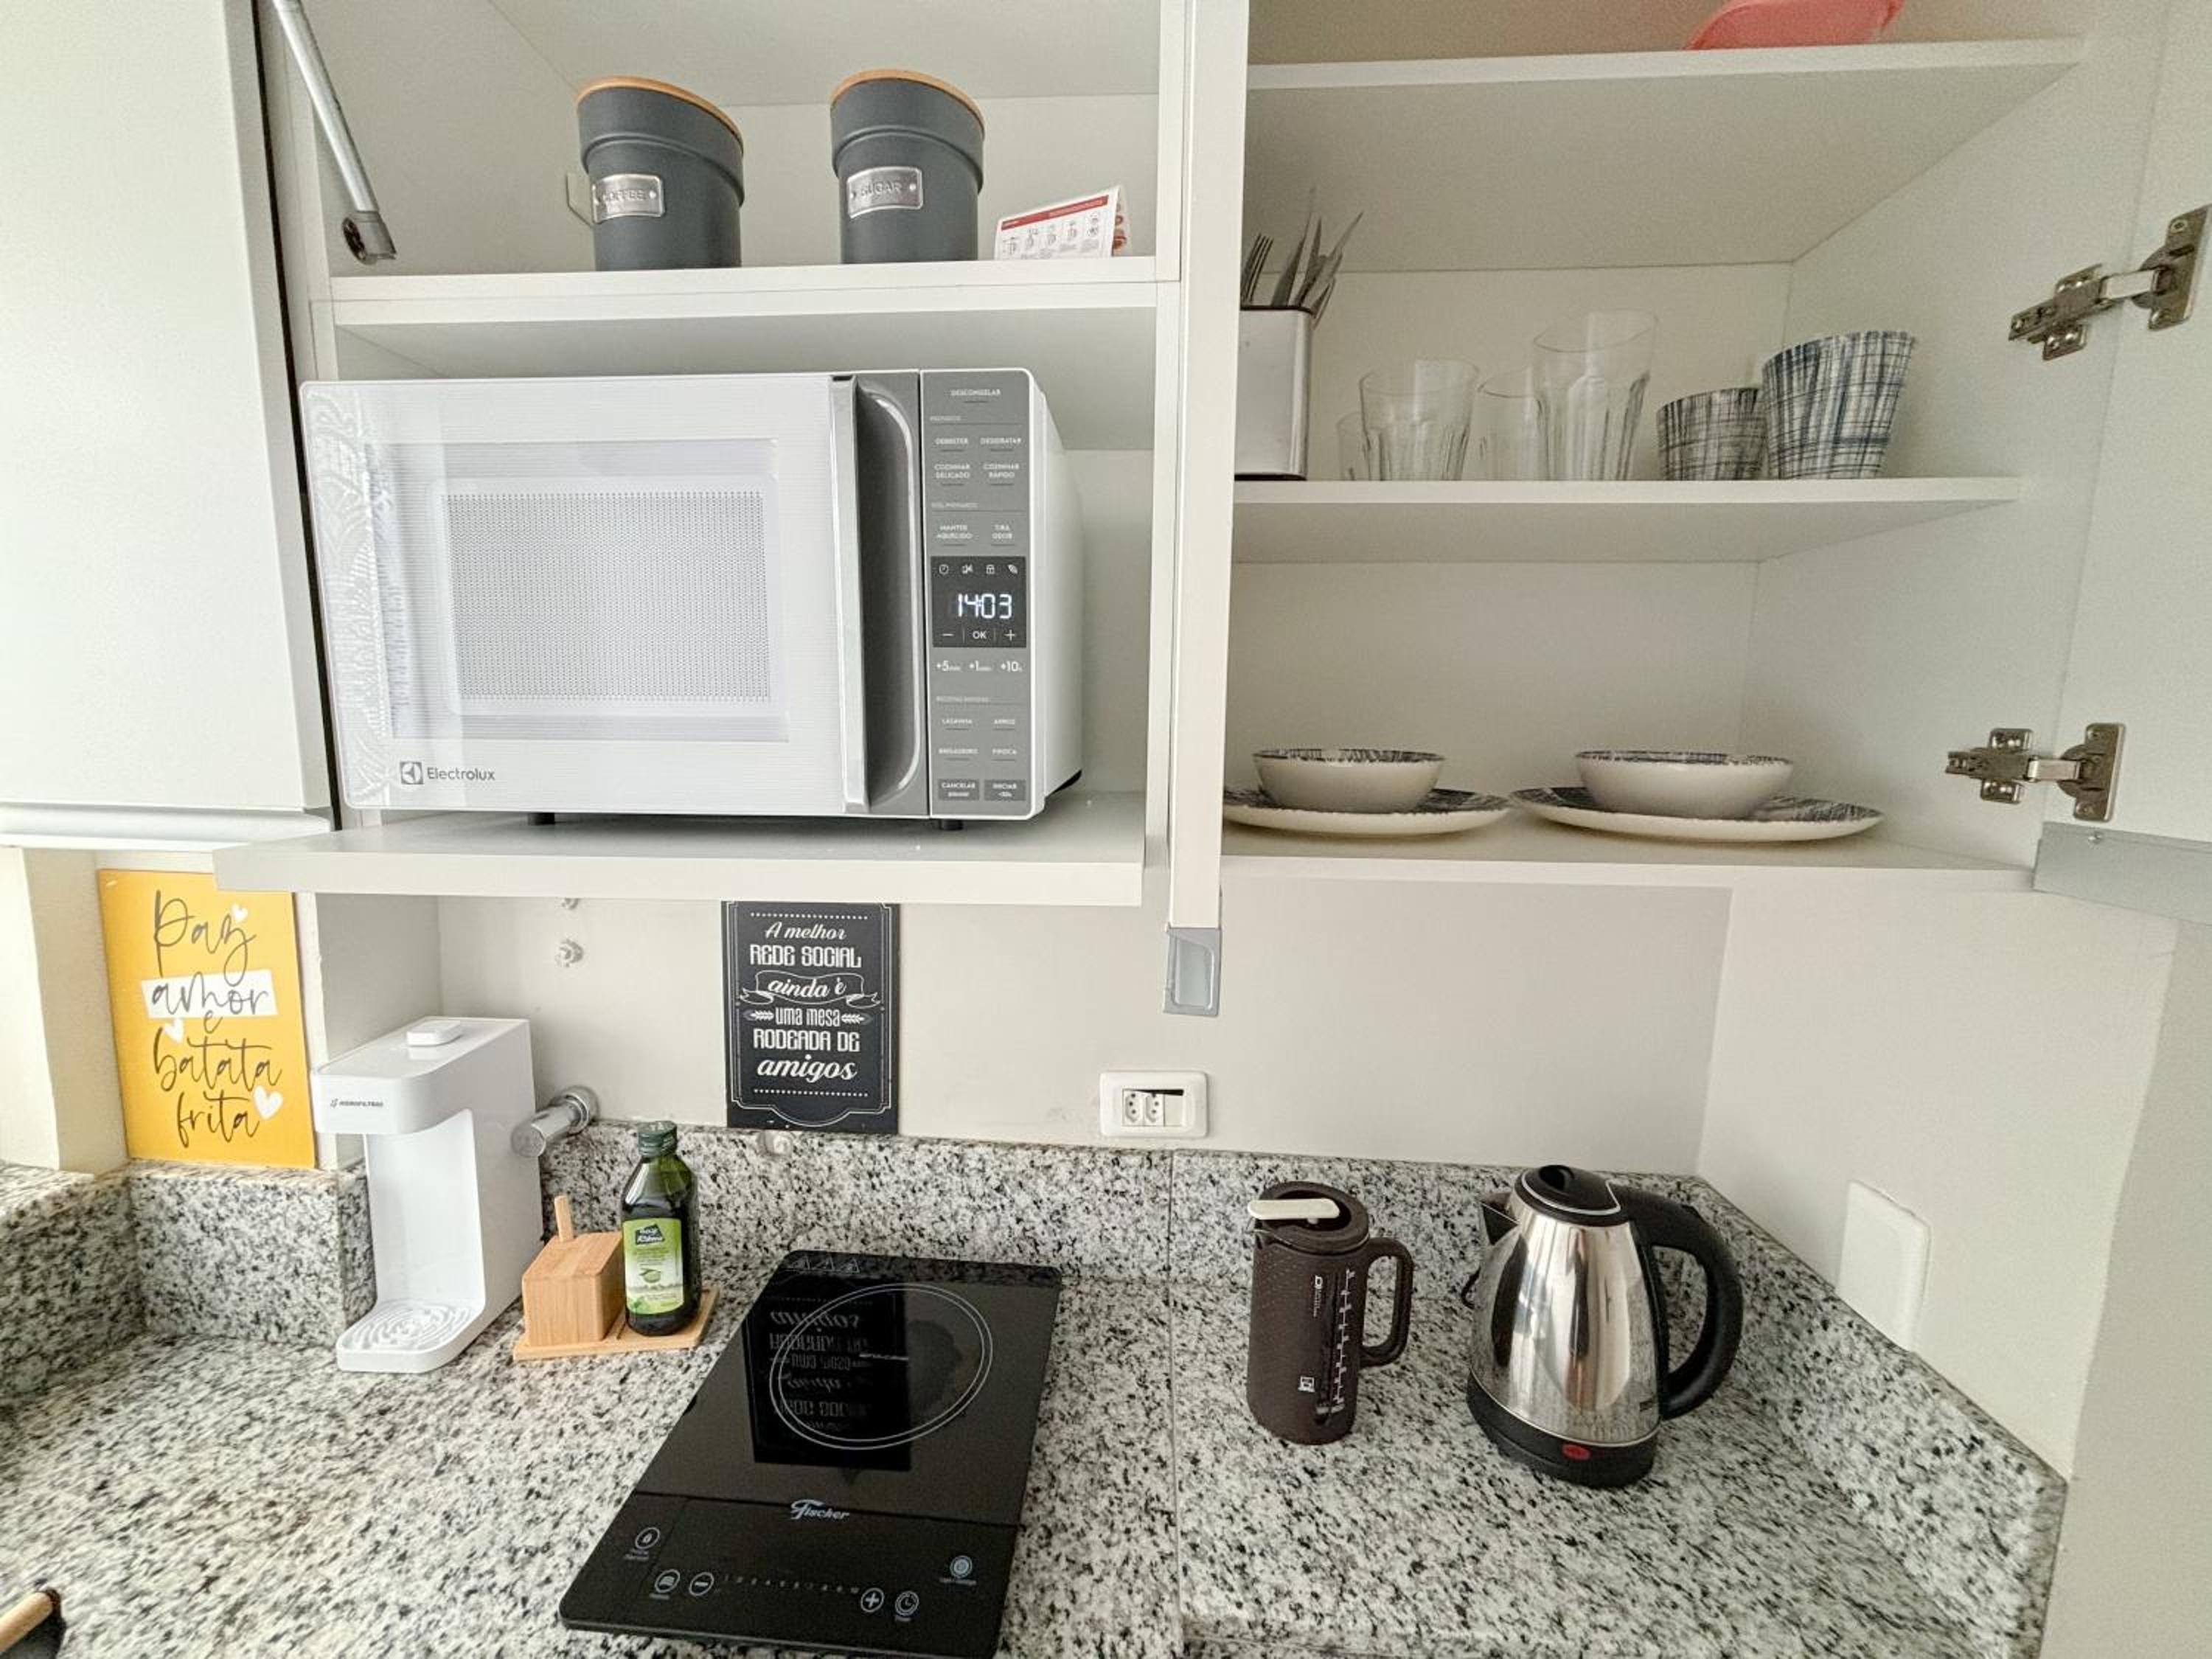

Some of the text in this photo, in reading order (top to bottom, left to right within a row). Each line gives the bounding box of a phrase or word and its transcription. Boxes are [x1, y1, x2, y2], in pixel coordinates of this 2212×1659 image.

[860, 181, 904, 196] SUGAR
[972, 630, 987, 639] OK
[427, 767, 495, 781] Electrolux
[765, 921, 847, 940] A melhor
[750, 944, 862, 968] REDE SOCIAL
[151, 971, 268, 1015] amor
[768, 978, 831, 998] ainda
[204, 1009, 223, 1034] e
[776, 1007, 841, 1027] uma mesa
[753, 1028, 860, 1052] RODEADA DE
[153, 1026, 282, 1092] batata
[757, 1054, 858, 1083] amigos
[176, 1090, 260, 1148] frita
[790, 1498, 850, 1520] Fischer
